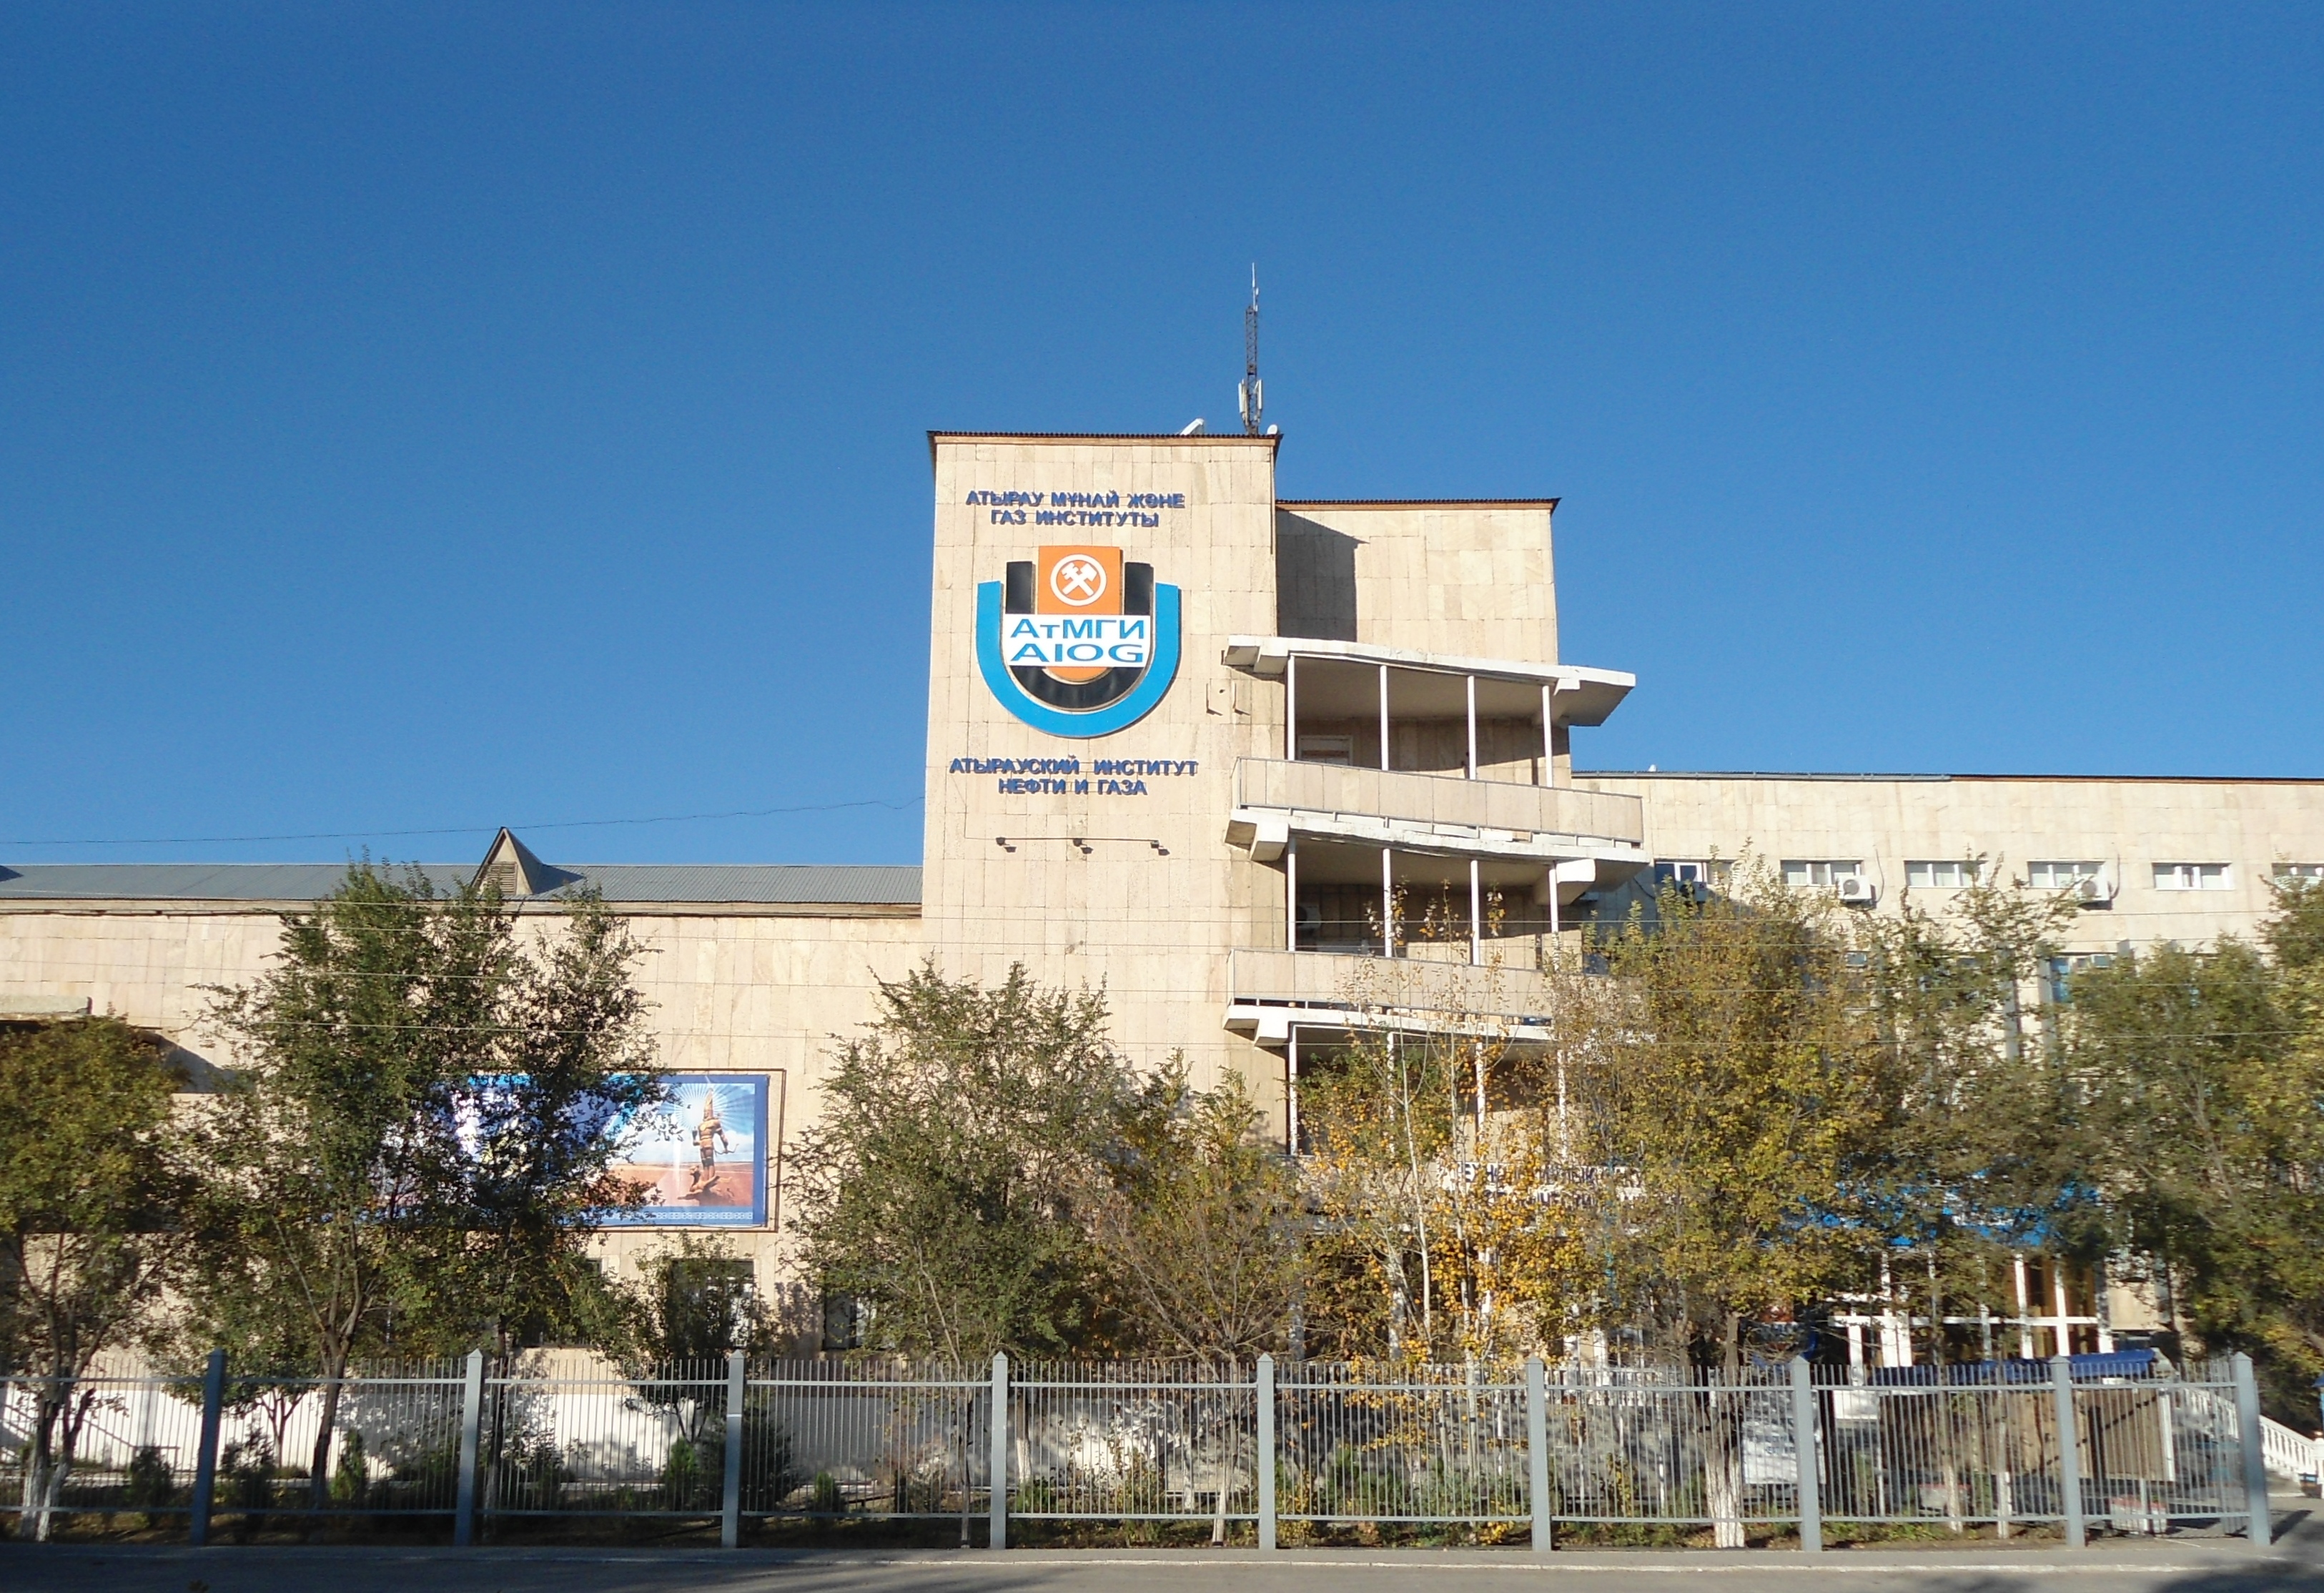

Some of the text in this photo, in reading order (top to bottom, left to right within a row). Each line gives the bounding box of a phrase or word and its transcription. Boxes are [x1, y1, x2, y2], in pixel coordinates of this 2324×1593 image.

[965, 490, 1044, 507] АТЫРАУ
[992, 509, 1159, 528] ГАЗ ИНСТИТУТЫ
[1010, 643, 1144, 663] AIOG
[949, 754, 1199, 776] АТЫРАУСКИЙ ИНСТИТУТ
[999, 778, 1148, 796] НЕФТИ И ГАЗА
